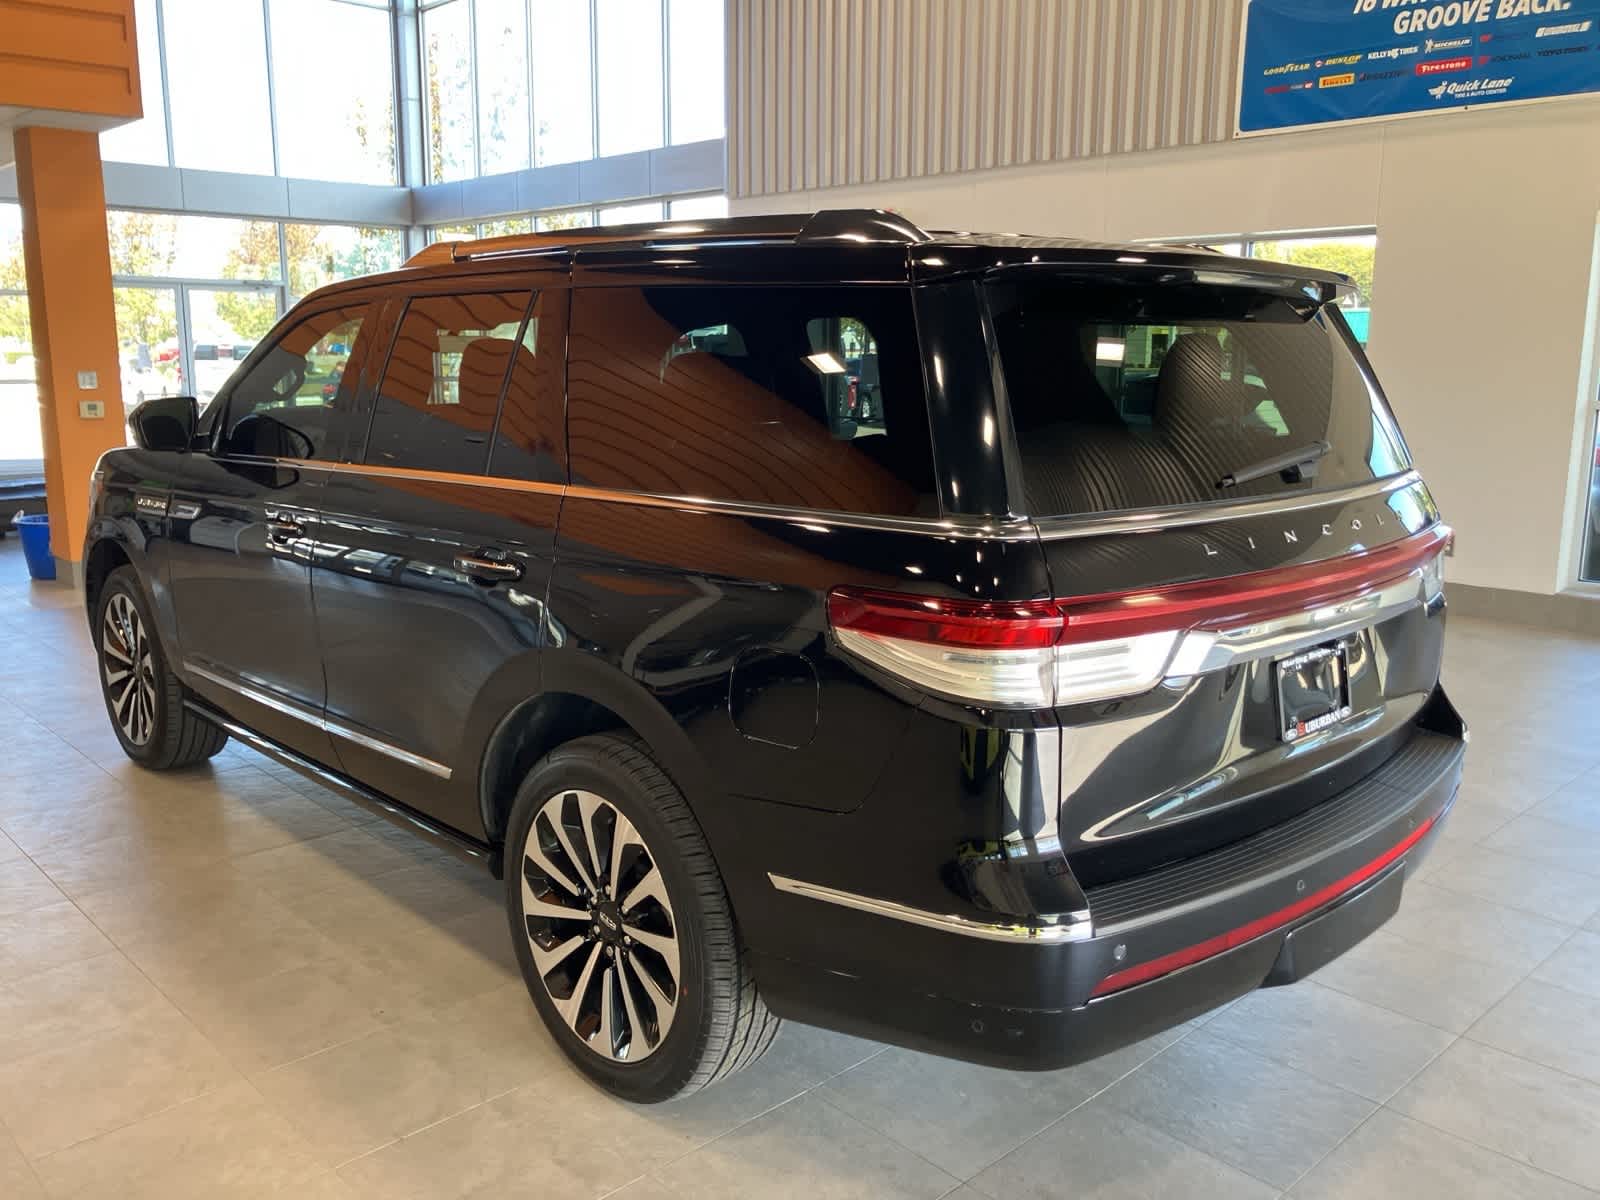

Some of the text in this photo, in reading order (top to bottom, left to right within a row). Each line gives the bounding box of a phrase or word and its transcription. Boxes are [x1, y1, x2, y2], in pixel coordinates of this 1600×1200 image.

[1393, 0, 1491, 35] GROOVE
[1263, 63, 1310, 75] GOODYEAR
[1421, 61, 1466, 73] Firestone
[1447, 78, 1513, 94] Quick Lane
[1204, 510, 1402, 555] LINCOL
[1296, 709, 1341, 736] SUBURBAN
